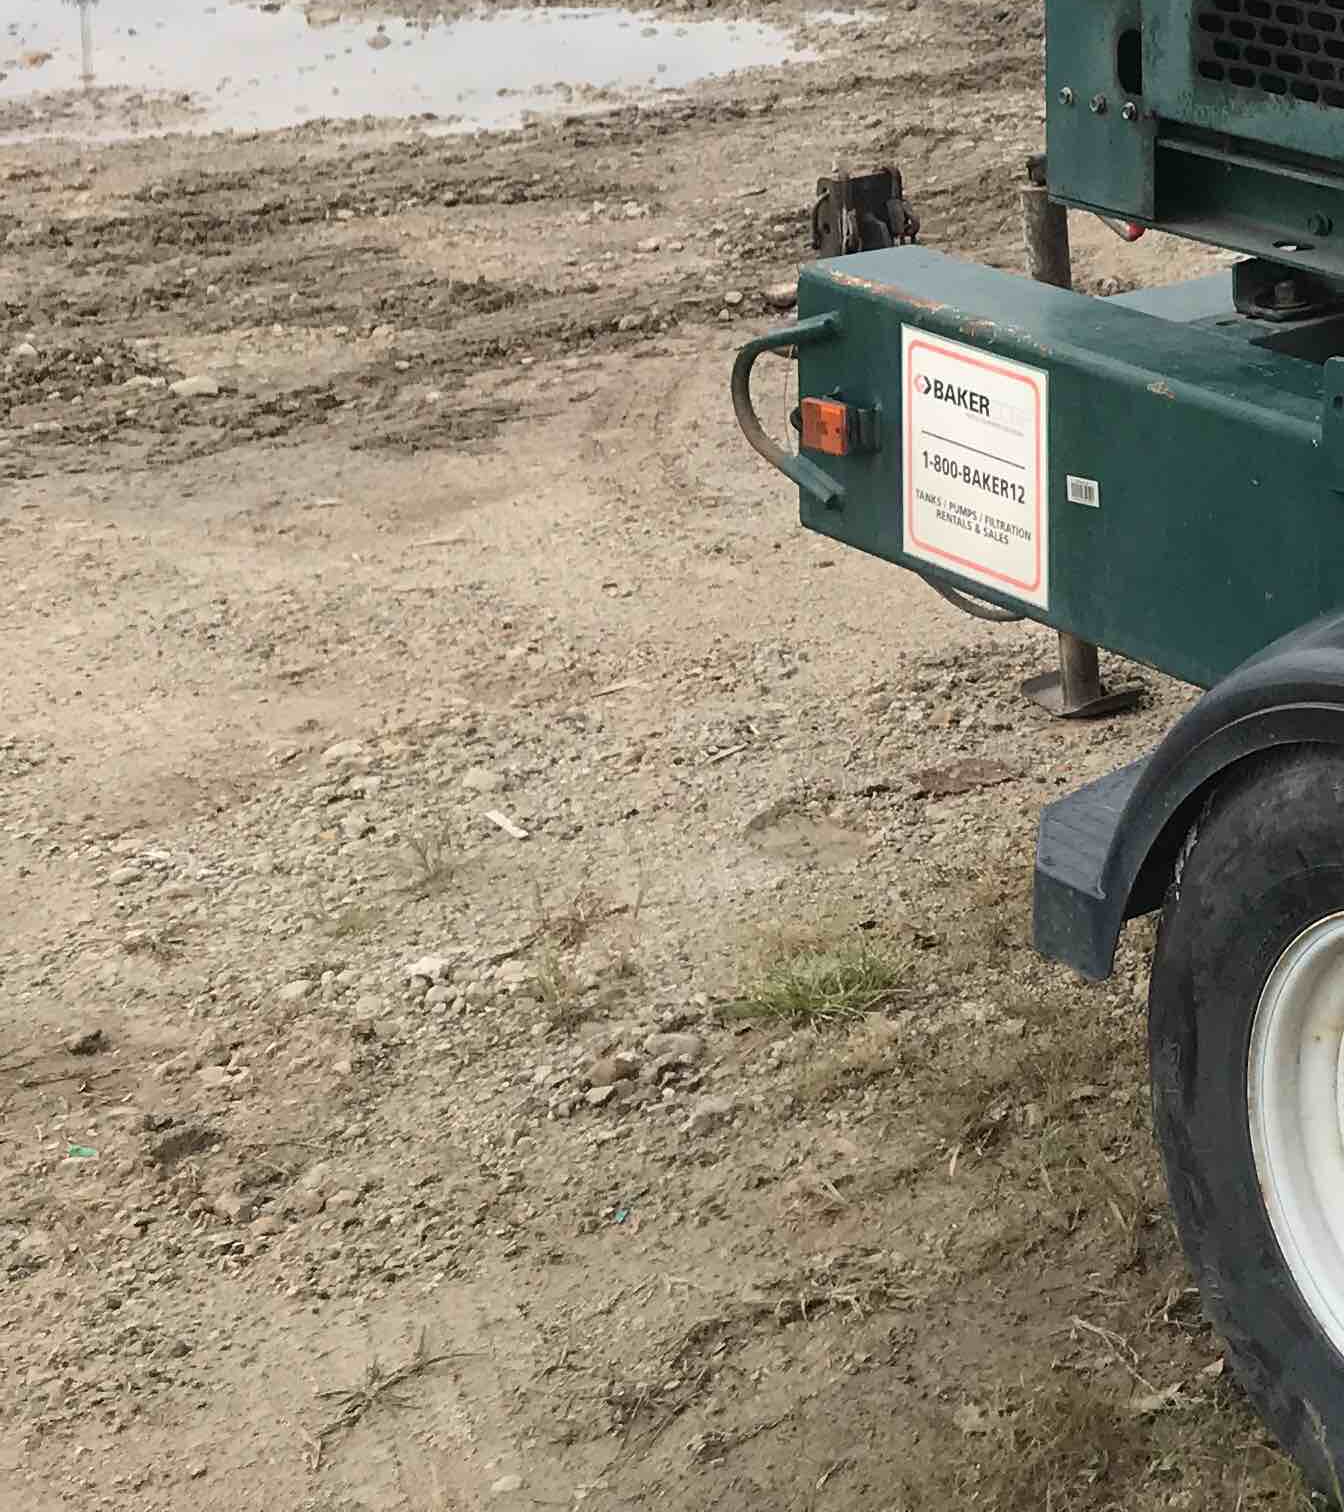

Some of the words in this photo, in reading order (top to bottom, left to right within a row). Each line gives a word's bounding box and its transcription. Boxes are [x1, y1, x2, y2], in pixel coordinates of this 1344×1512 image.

[933, 380, 991, 417] BAKER
[923, 450, 1026, 504] 1-800-BAKER12
[915, 488, 941, 507] TANKS
[949, 502, 977, 520] PUMPS
[985, 515, 1031, 541] FILTRATION
[936, 509, 972, 530] RENTALS
[984, 528, 1009, 544] SALES
